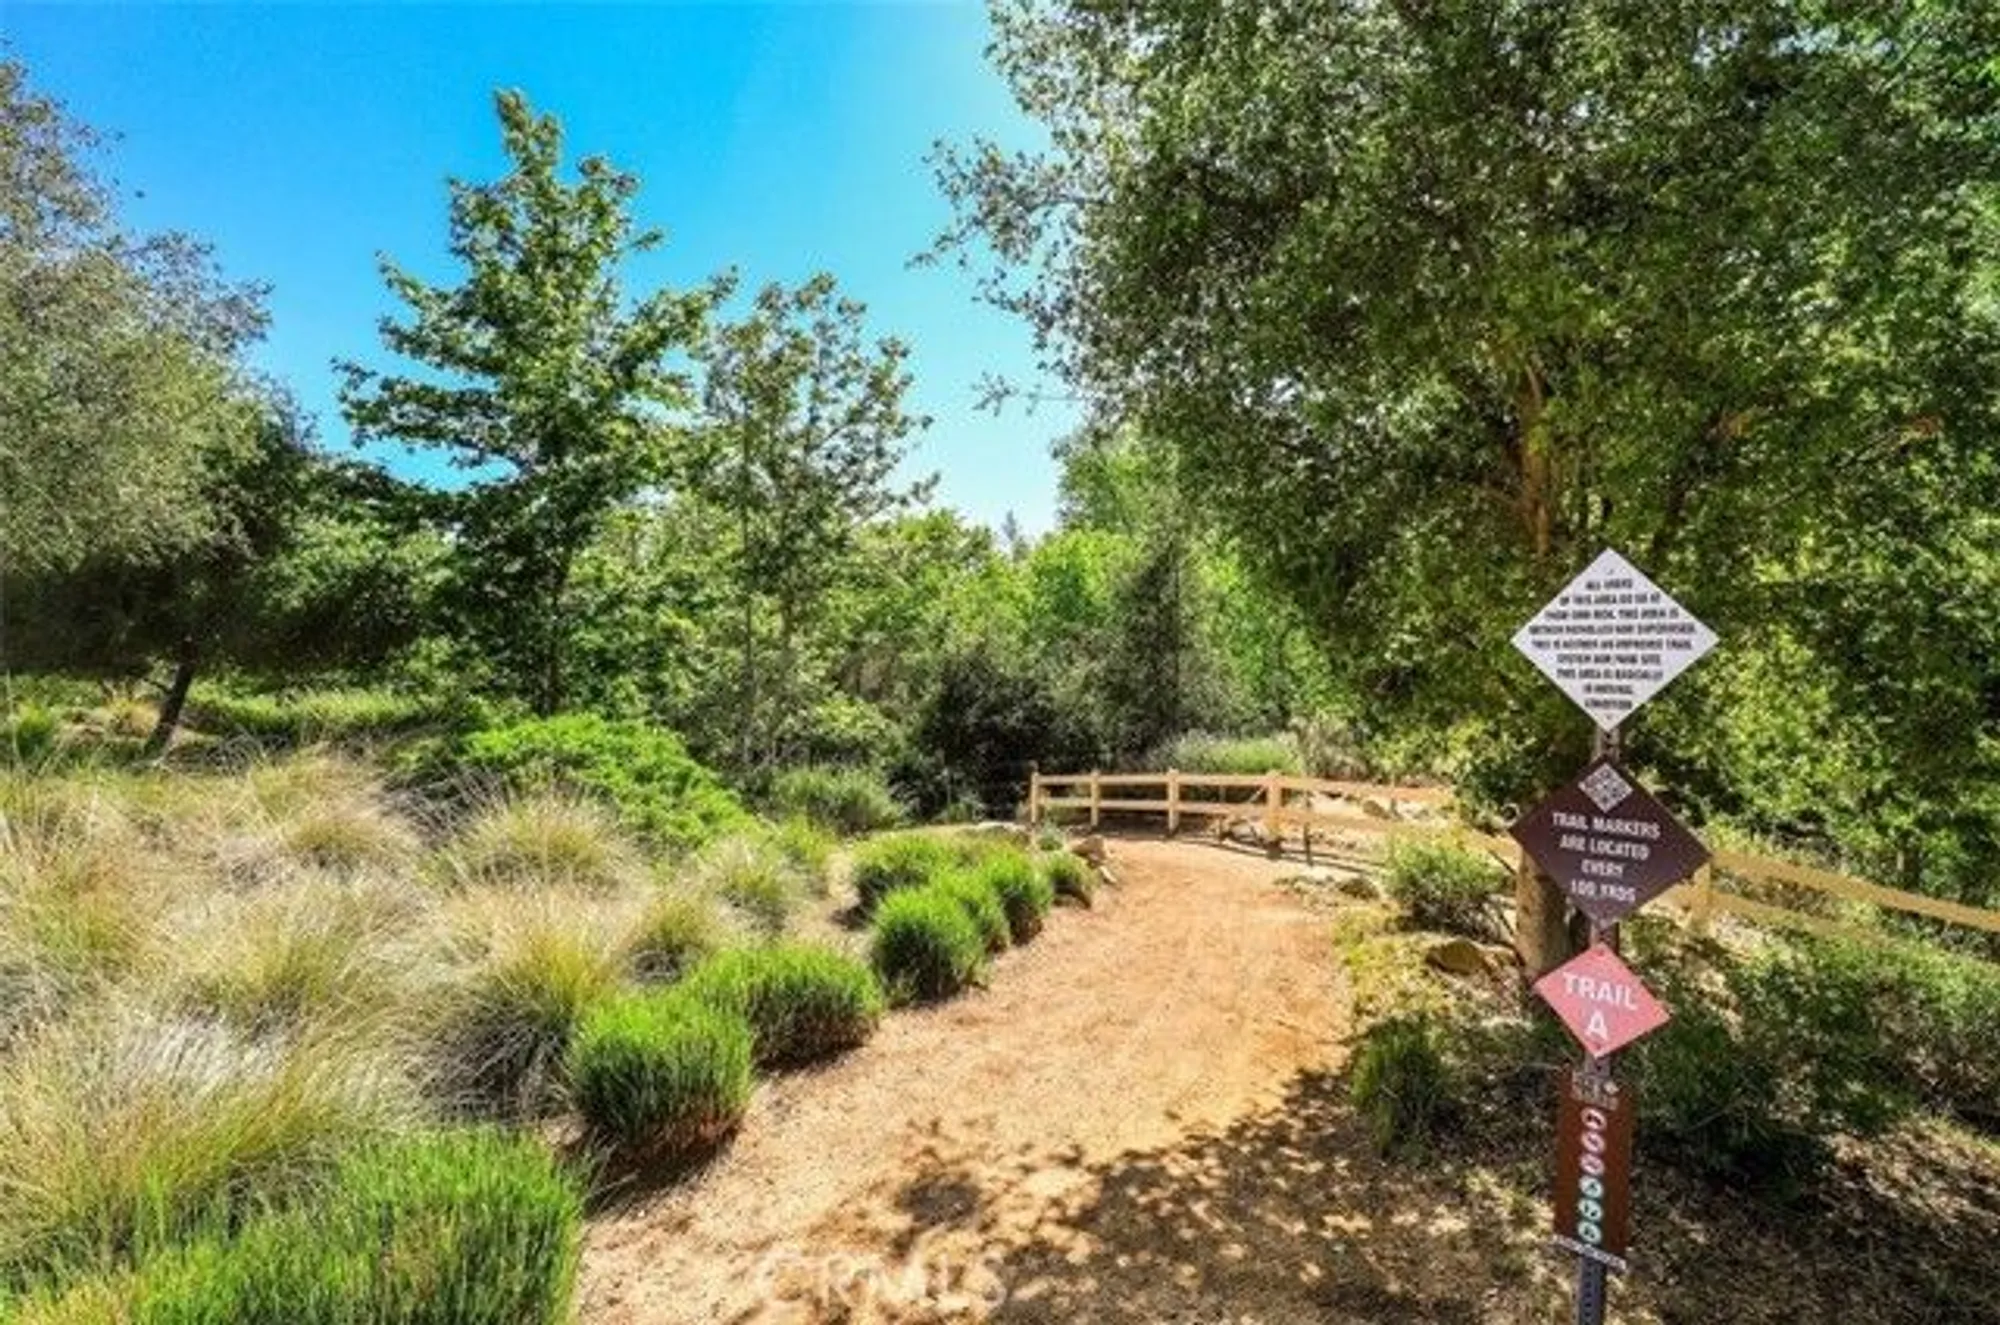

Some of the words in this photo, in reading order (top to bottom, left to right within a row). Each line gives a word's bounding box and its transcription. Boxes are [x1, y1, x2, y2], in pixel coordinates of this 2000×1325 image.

[1552, 812, 1589, 831] TRAIL
[1592, 815, 1662, 841] MARKERS
[1559, 834, 1586, 852] ARE
[1589, 837, 1650, 861] LOCATED
[1580, 858, 1625, 878] EVERY
[1570, 879, 1596, 896] 100
[1563, 971, 1639, 1012] TRAIL
[1584, 1009, 1609, 1042] A
